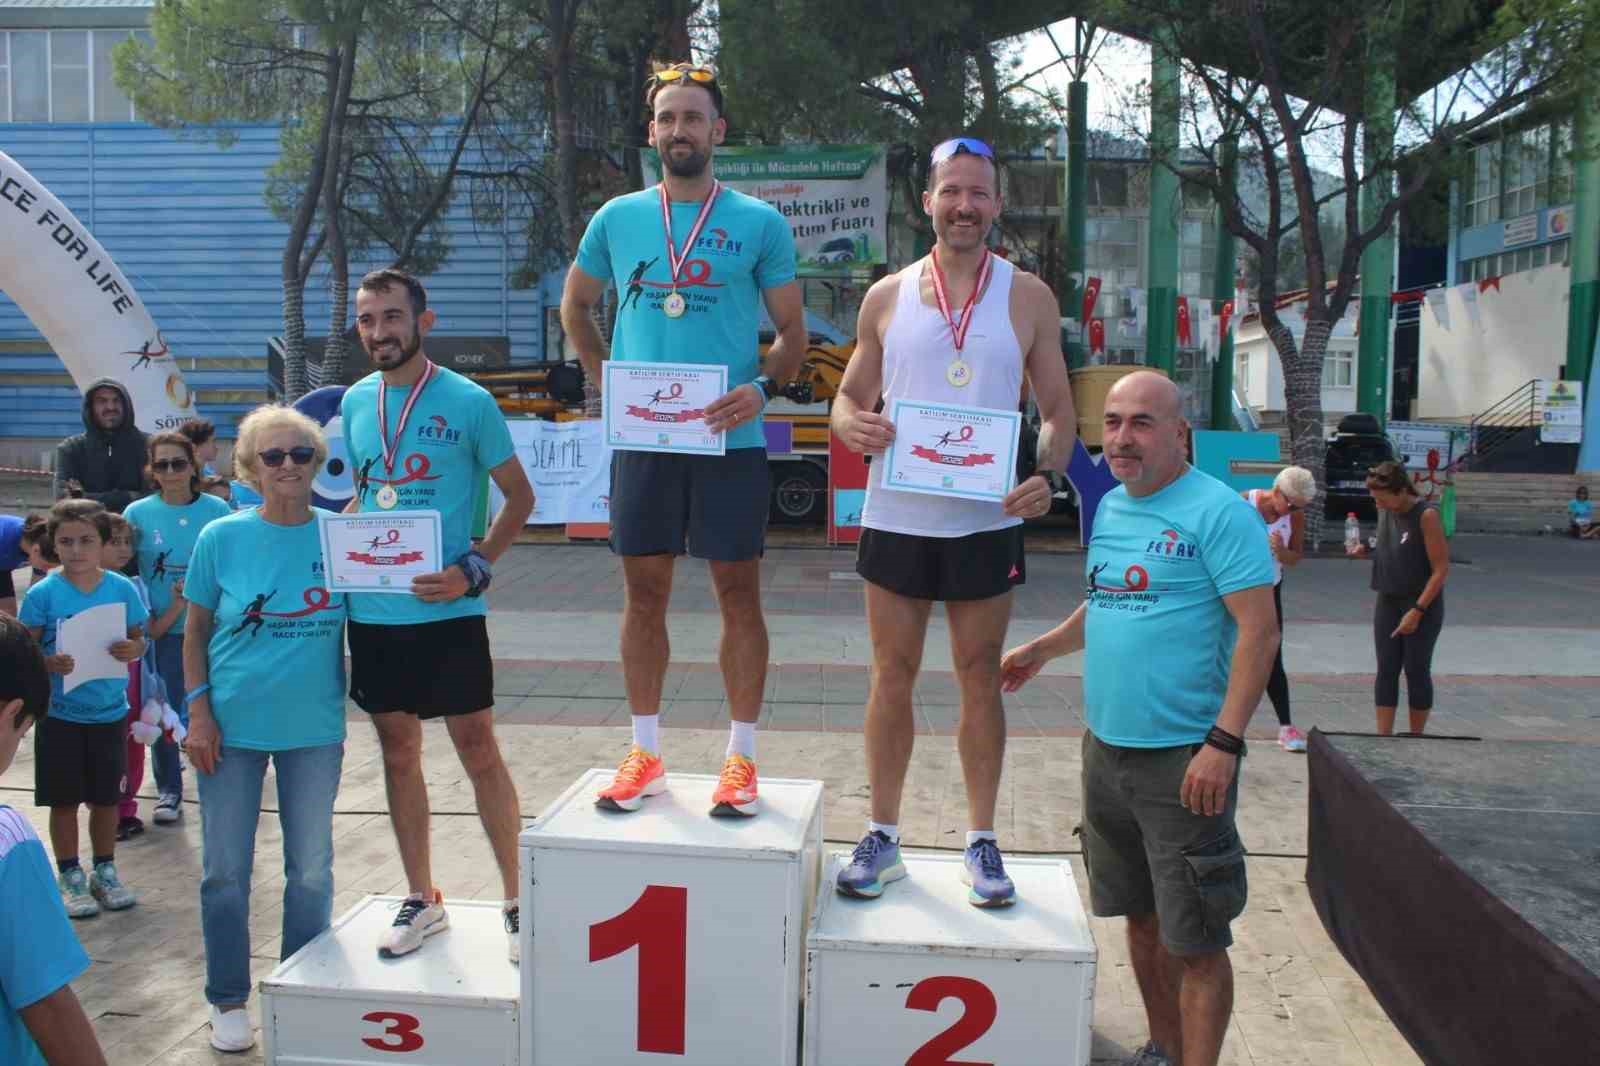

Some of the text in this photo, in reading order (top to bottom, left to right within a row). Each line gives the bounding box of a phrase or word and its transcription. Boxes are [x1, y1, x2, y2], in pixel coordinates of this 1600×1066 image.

[767, 160, 819, 173] Mücadele
[850, 196, 871, 210] ve
[831, 216, 875, 232] Fuarı
[0, 172, 133, 315] CE FOR LIFE
[697, 239, 743, 253] FETAV
[418, 425, 461, 441] FETAV
[1146, 541, 1195, 558] FETAV
[1130, 602, 1149, 613] LIFE
[588, 885, 687, 1055] 1
[905, 975, 998, 1066] 2
[361, 1011, 424, 1053] 3
